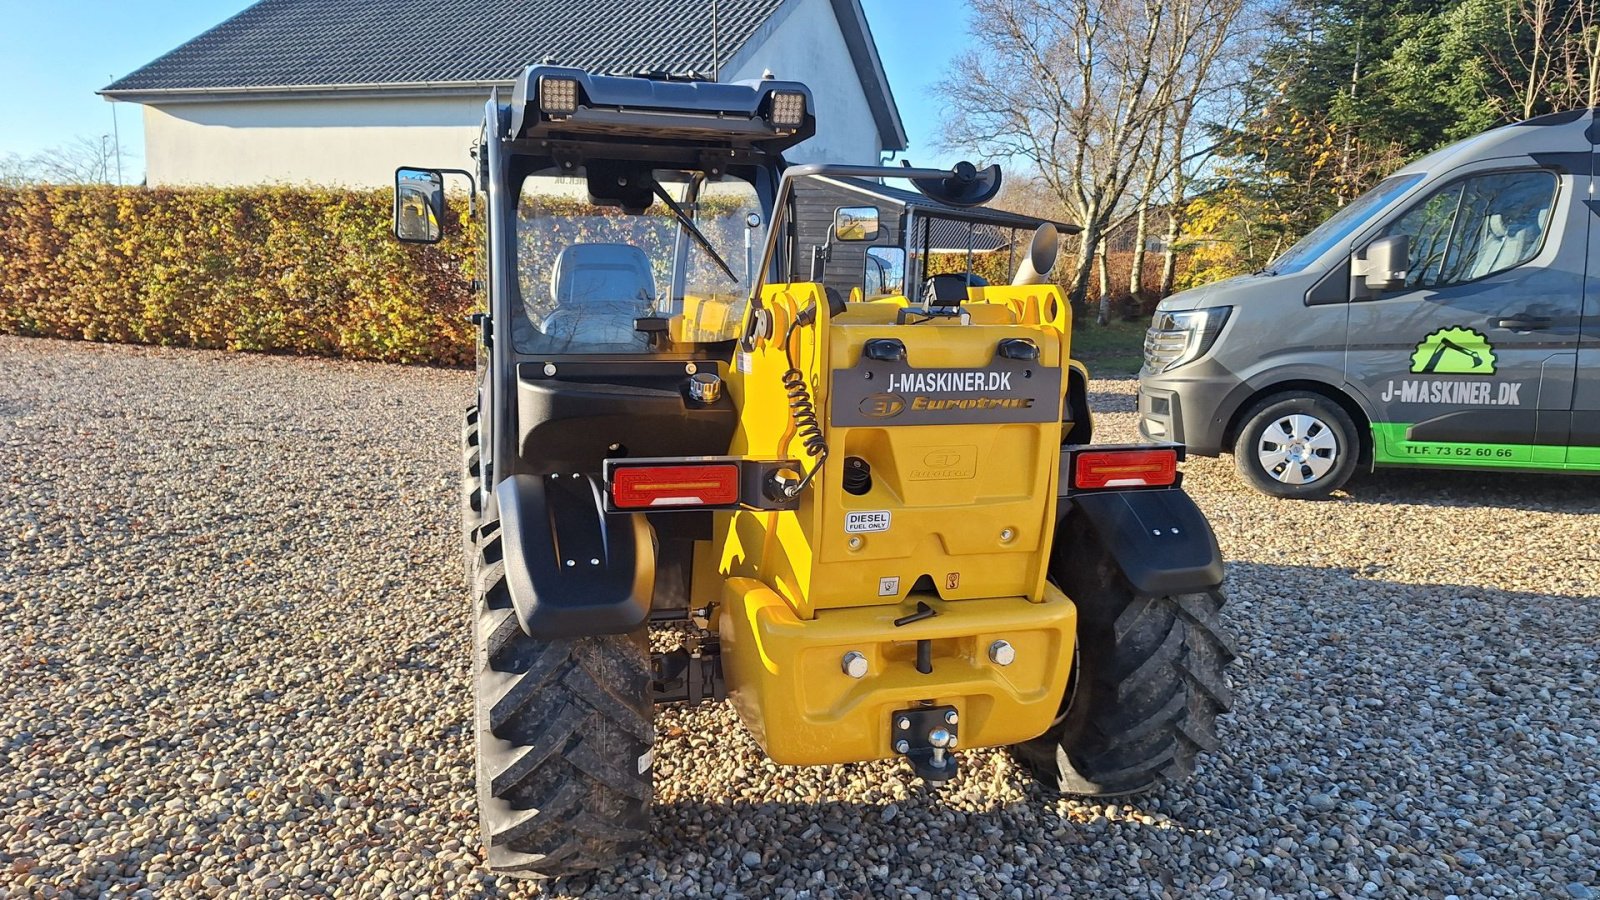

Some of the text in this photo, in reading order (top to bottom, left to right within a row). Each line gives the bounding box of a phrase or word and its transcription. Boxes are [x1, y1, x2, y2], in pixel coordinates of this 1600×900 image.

[887, 371, 1012, 393] J-MASKINER.DK
[1381, 379, 1522, 406] J-MASKINER.DK
[1405, 445, 1513, 458] TLF. 73 62 60 66
[850, 514, 887, 523] DIESEL
